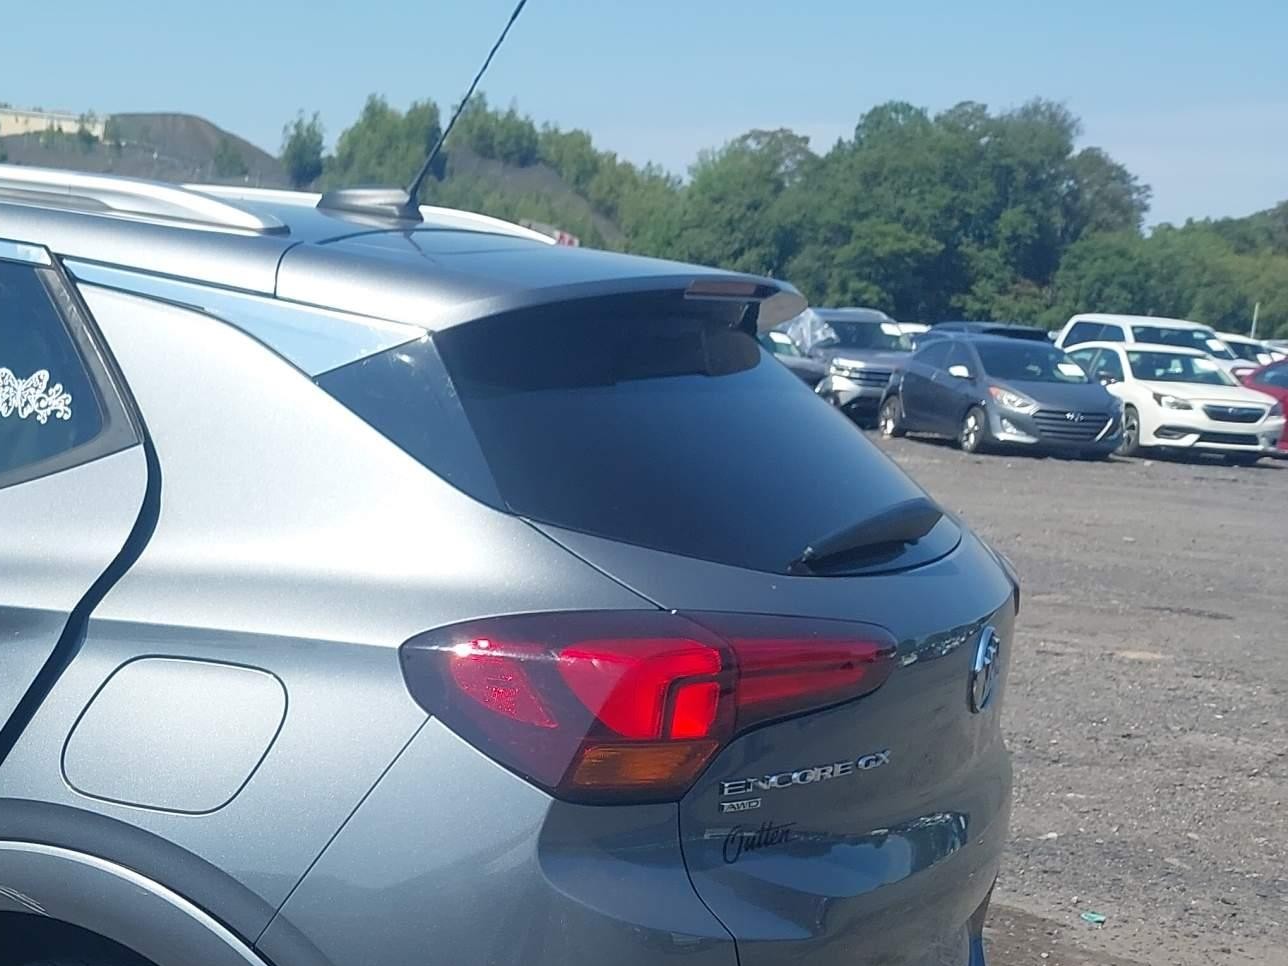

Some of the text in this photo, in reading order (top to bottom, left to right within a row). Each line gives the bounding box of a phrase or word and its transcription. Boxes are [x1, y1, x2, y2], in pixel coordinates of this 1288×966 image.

[720, 750, 892, 796] ENCORE GX
[725, 800, 760, 812] AWD
